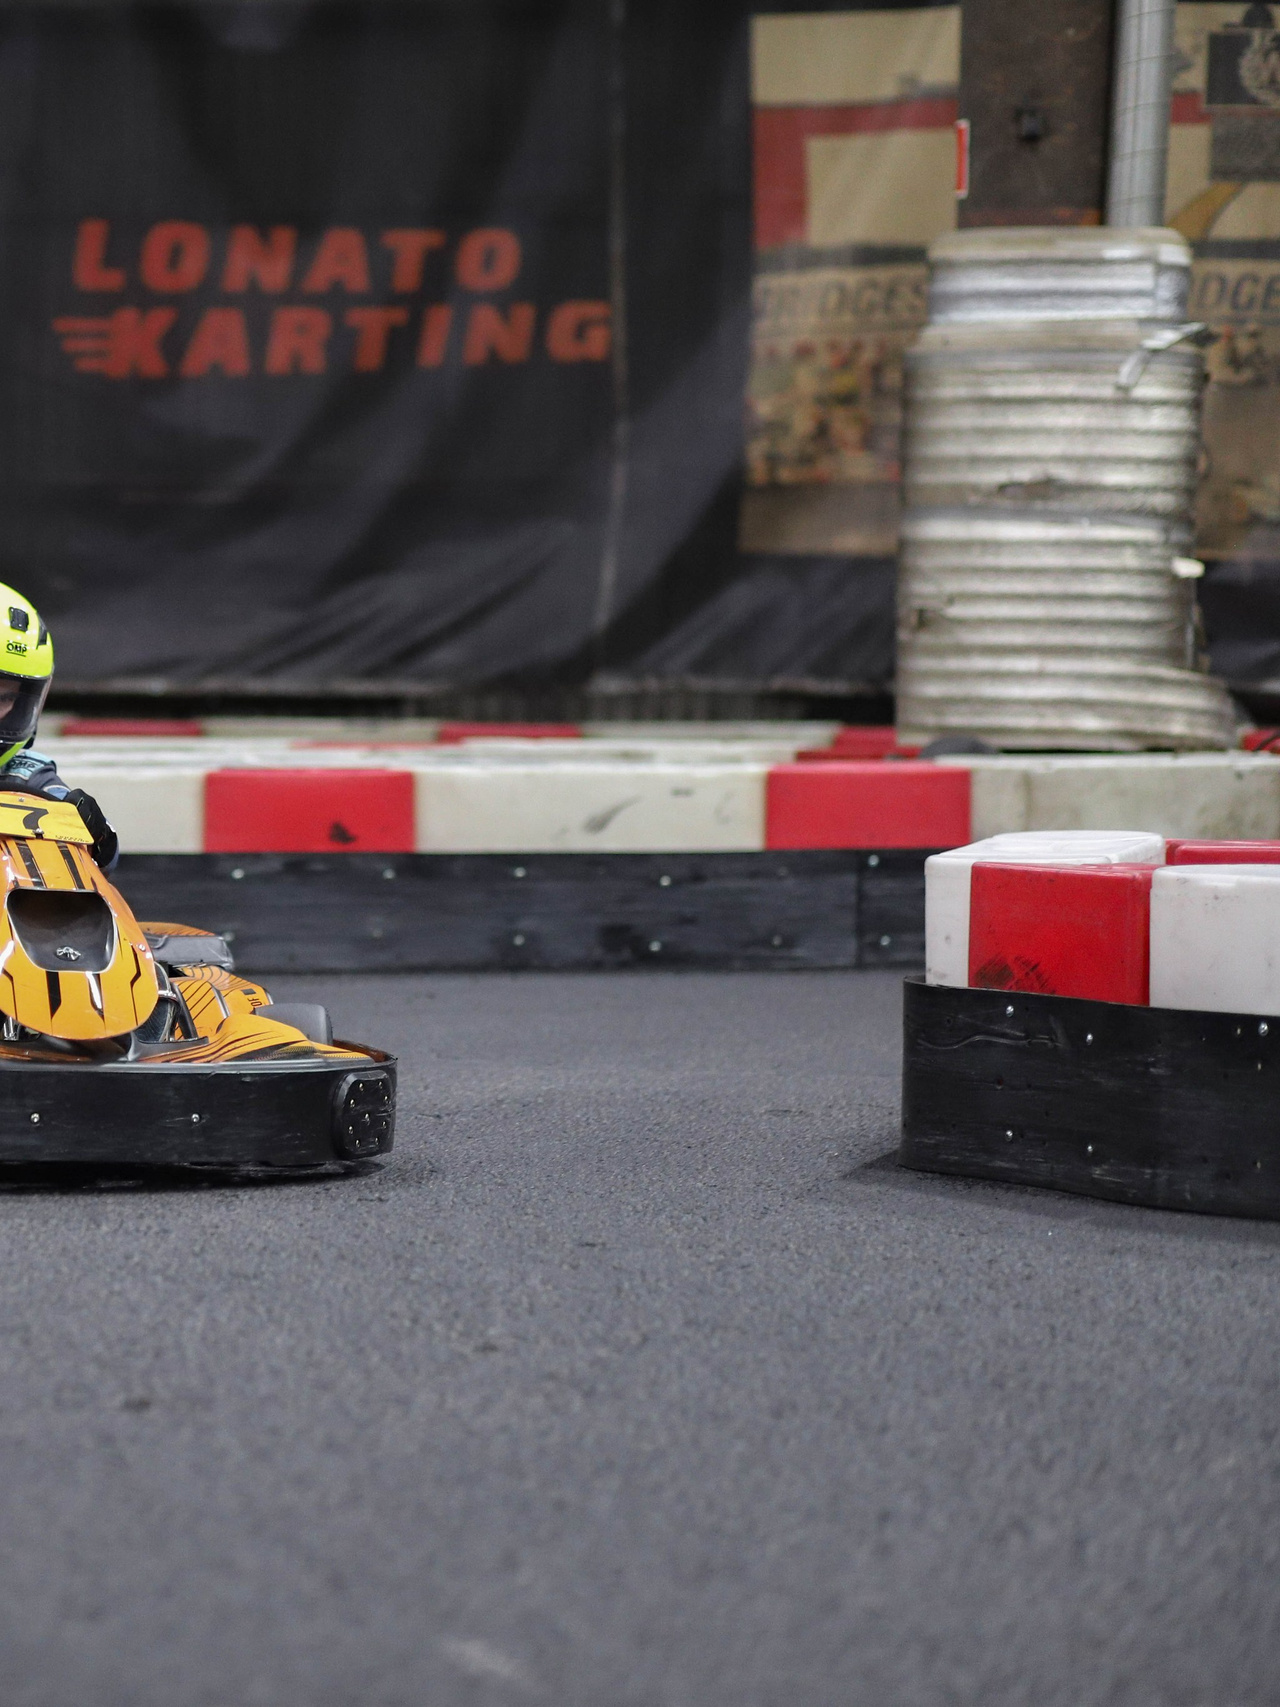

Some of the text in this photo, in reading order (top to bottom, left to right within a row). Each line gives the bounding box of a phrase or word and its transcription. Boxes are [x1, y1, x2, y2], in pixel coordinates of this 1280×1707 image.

[72, 217, 522, 293] LONATO
[102, 300, 612, 379] KARTING
[6, 642, 27, 654] OMP
